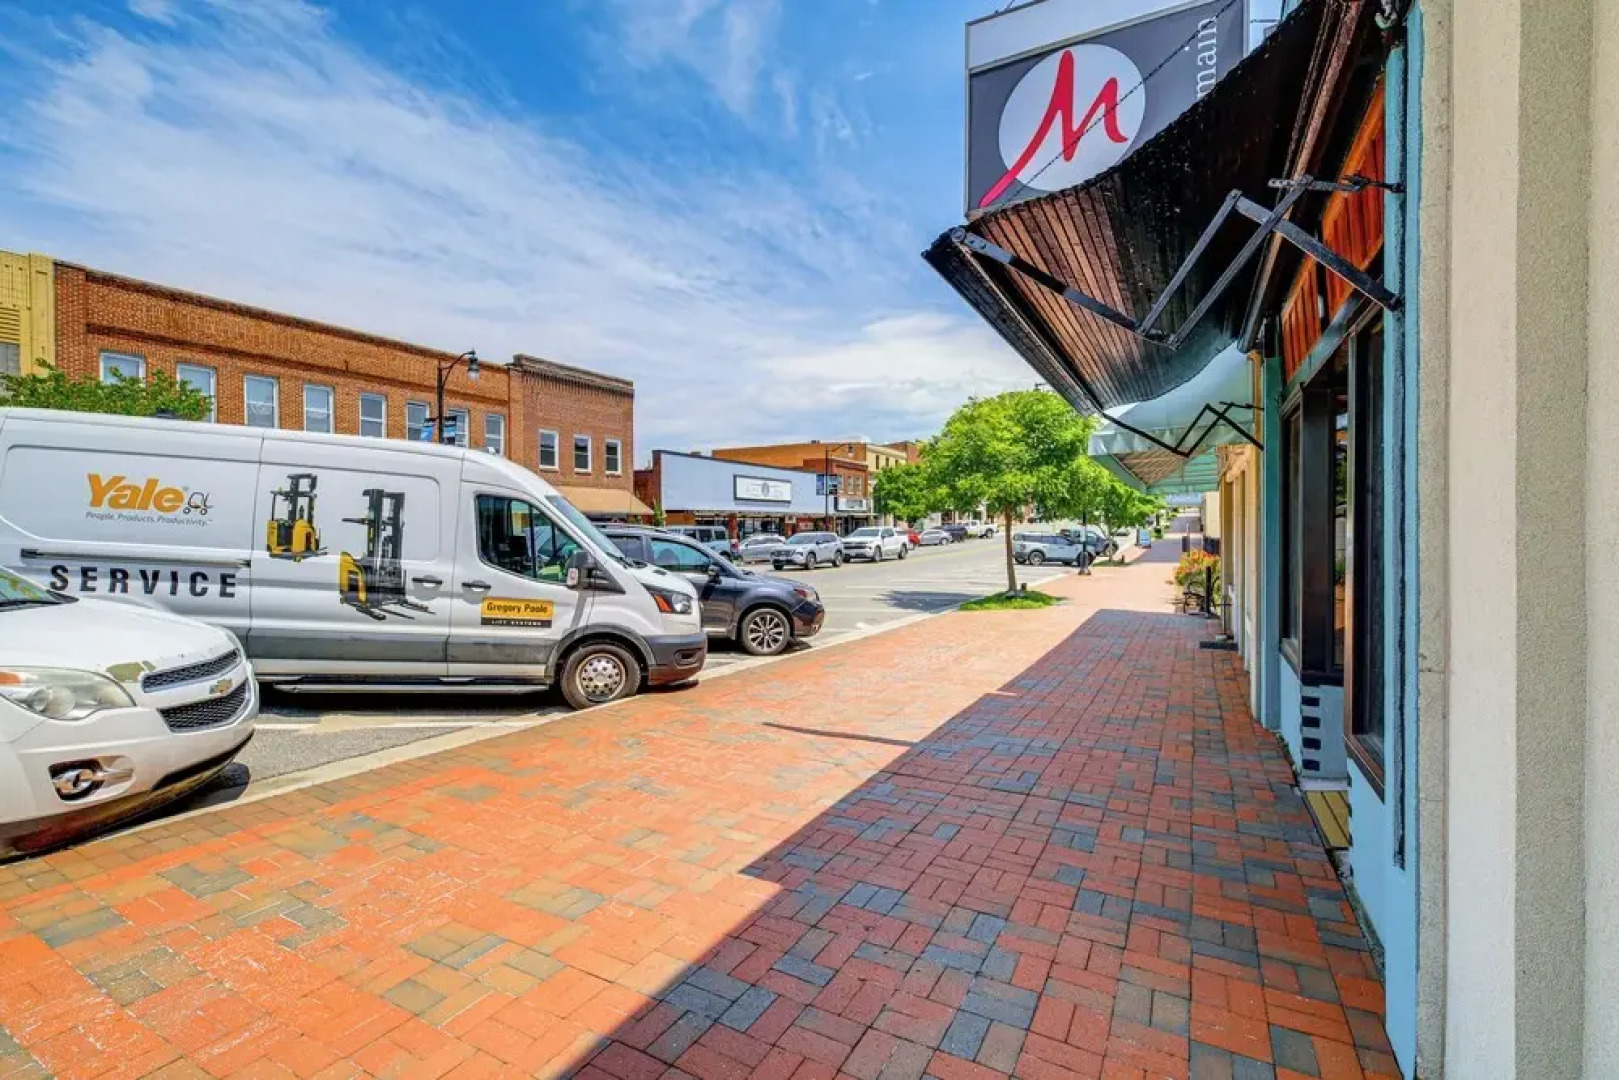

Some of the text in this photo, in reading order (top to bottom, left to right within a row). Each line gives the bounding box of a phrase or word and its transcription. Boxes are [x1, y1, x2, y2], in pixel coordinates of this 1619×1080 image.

[87, 472, 185, 513] Yale
[50, 565, 236, 598] SERVICE
[486, 602, 521, 614] Gregory
